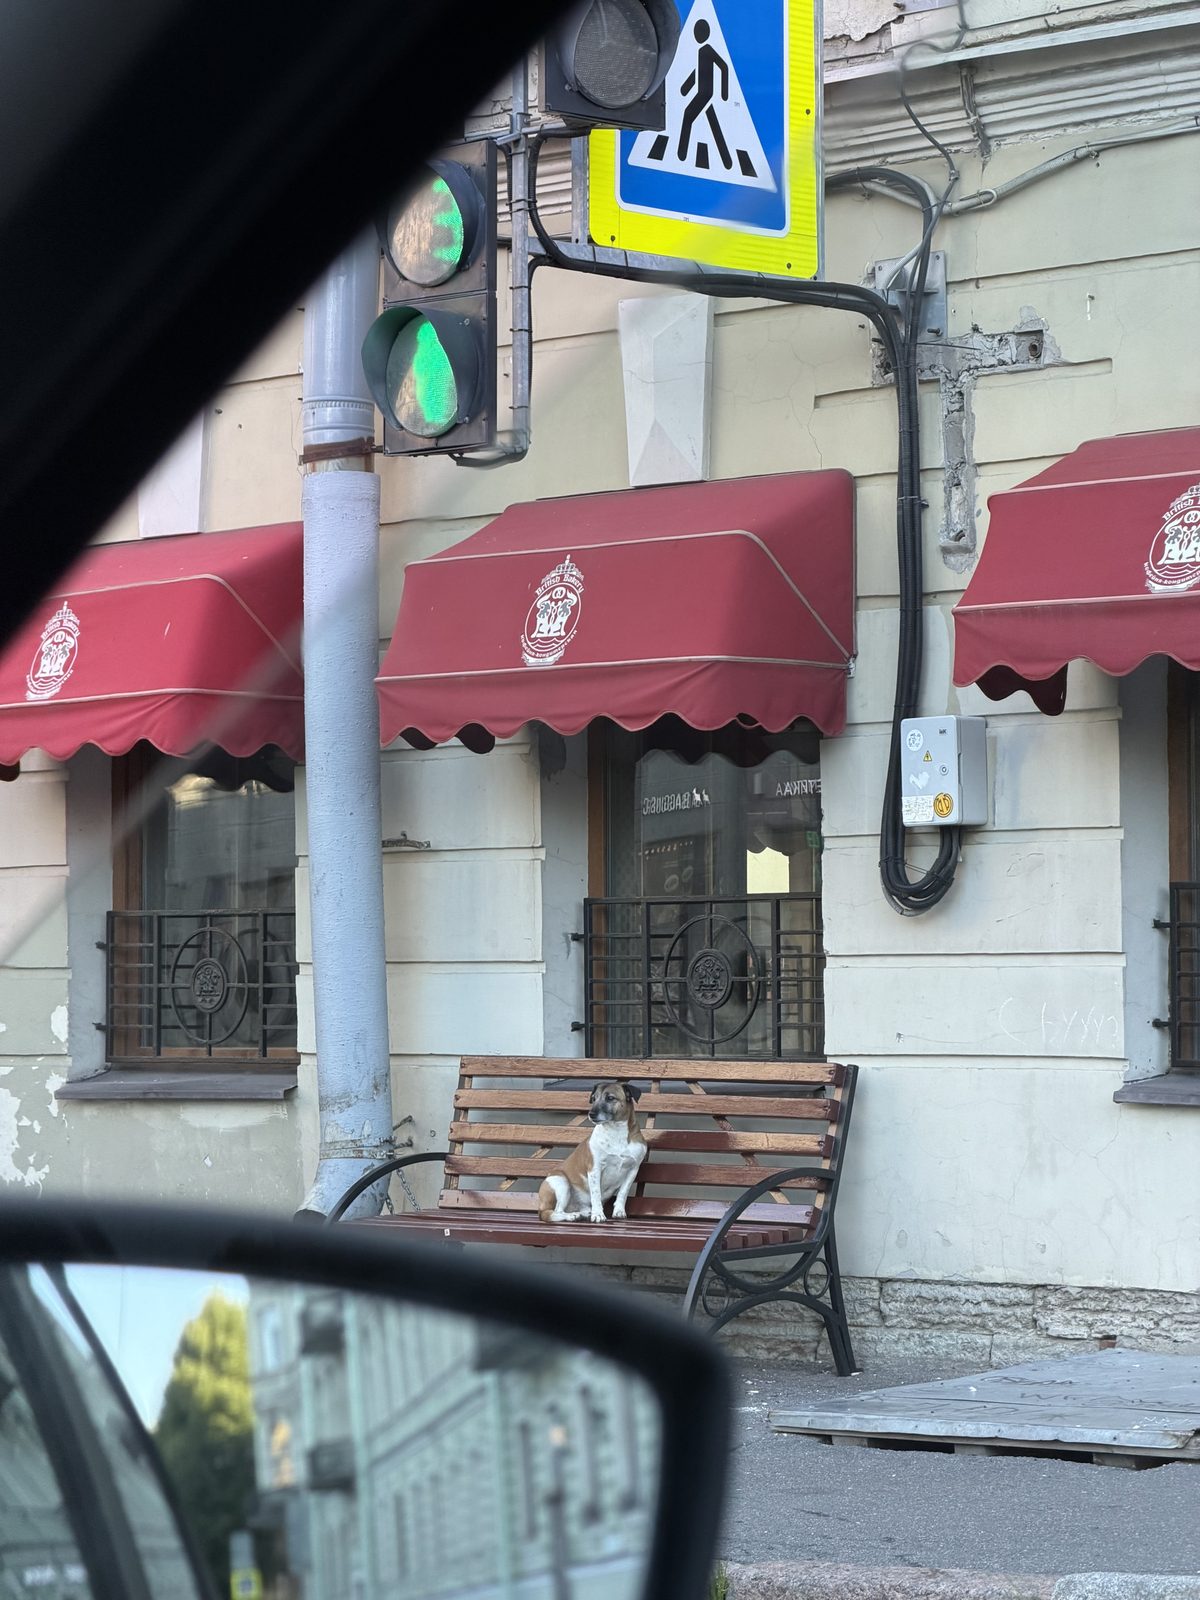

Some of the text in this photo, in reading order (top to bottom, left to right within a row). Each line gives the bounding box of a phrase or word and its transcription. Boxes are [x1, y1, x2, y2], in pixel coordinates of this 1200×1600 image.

[1162, 498, 1194, 521] British
[535, 574, 585, 596] British Bakery
